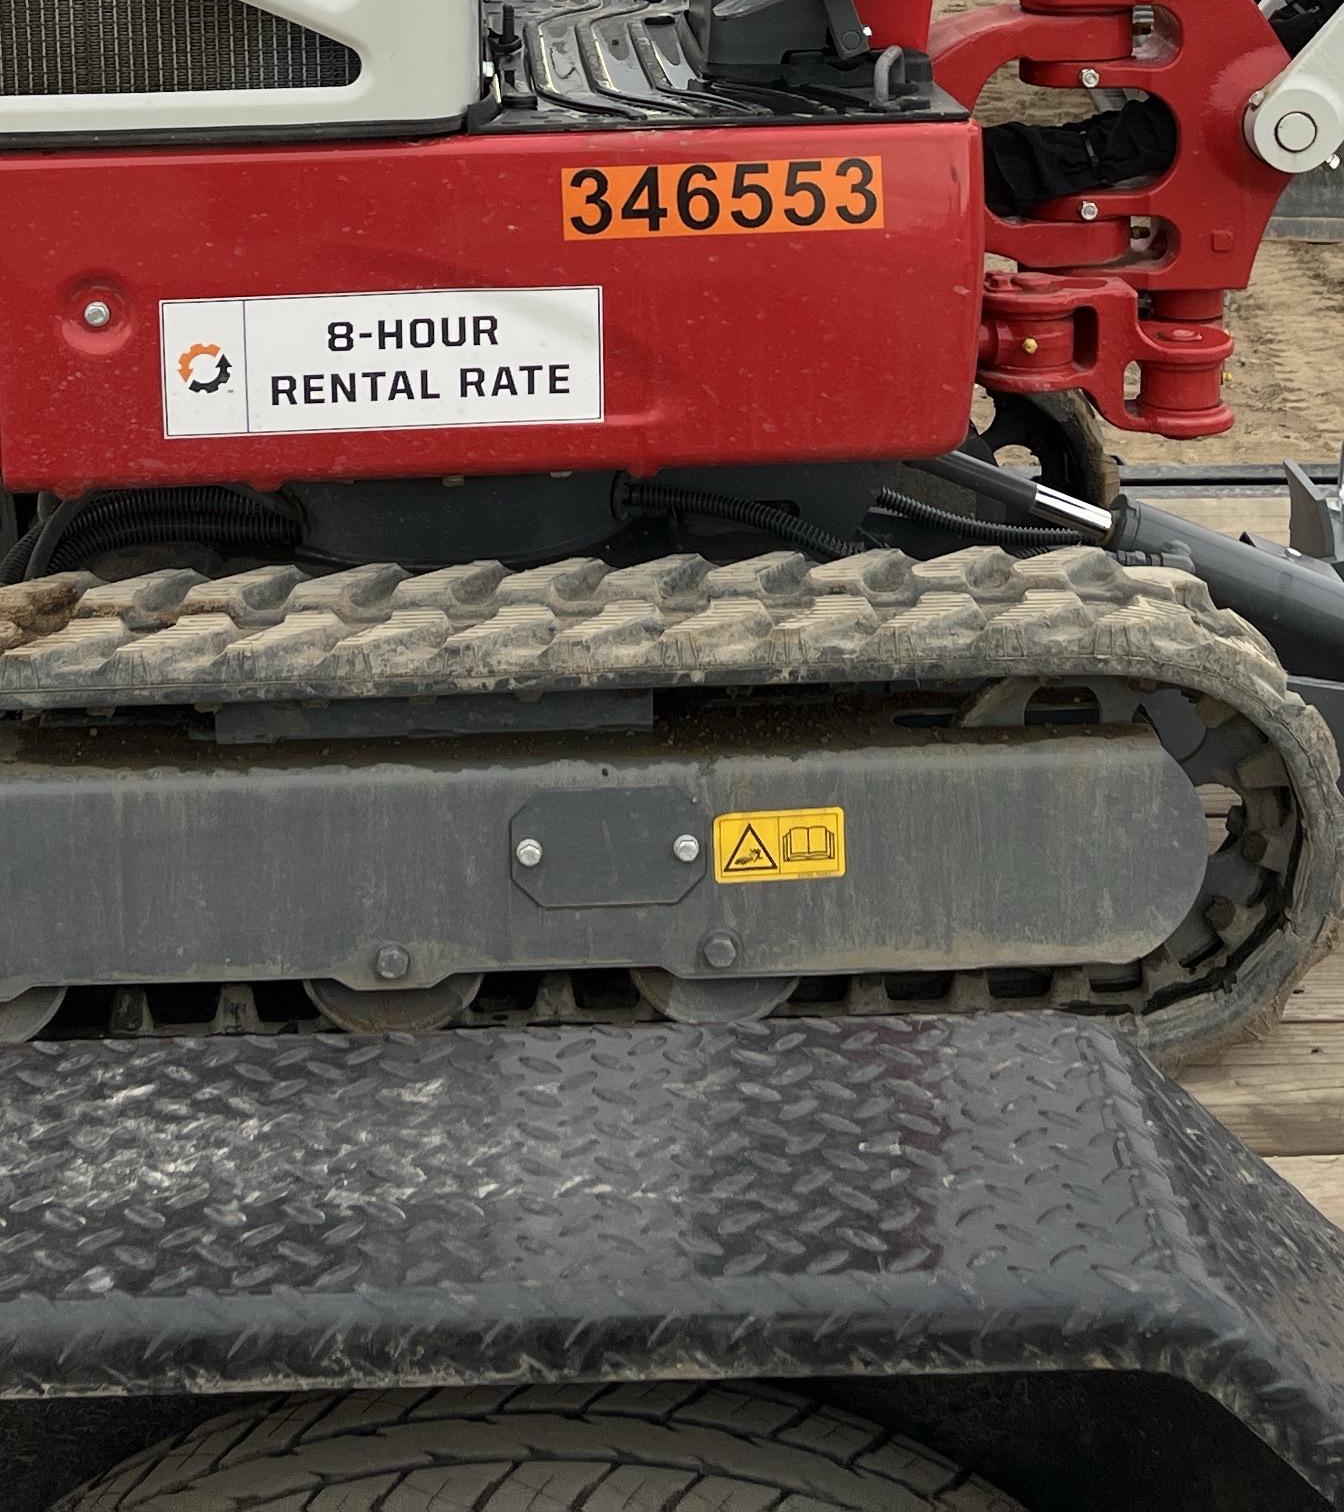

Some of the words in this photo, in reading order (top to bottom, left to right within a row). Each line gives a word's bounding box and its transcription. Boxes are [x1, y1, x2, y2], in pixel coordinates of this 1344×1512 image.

[569, 157, 878, 235] 346553
[326, 314, 499, 352] 8-HOUR
[270, 369, 441, 406] RENTAL
[459, 363, 571, 398] RATE
